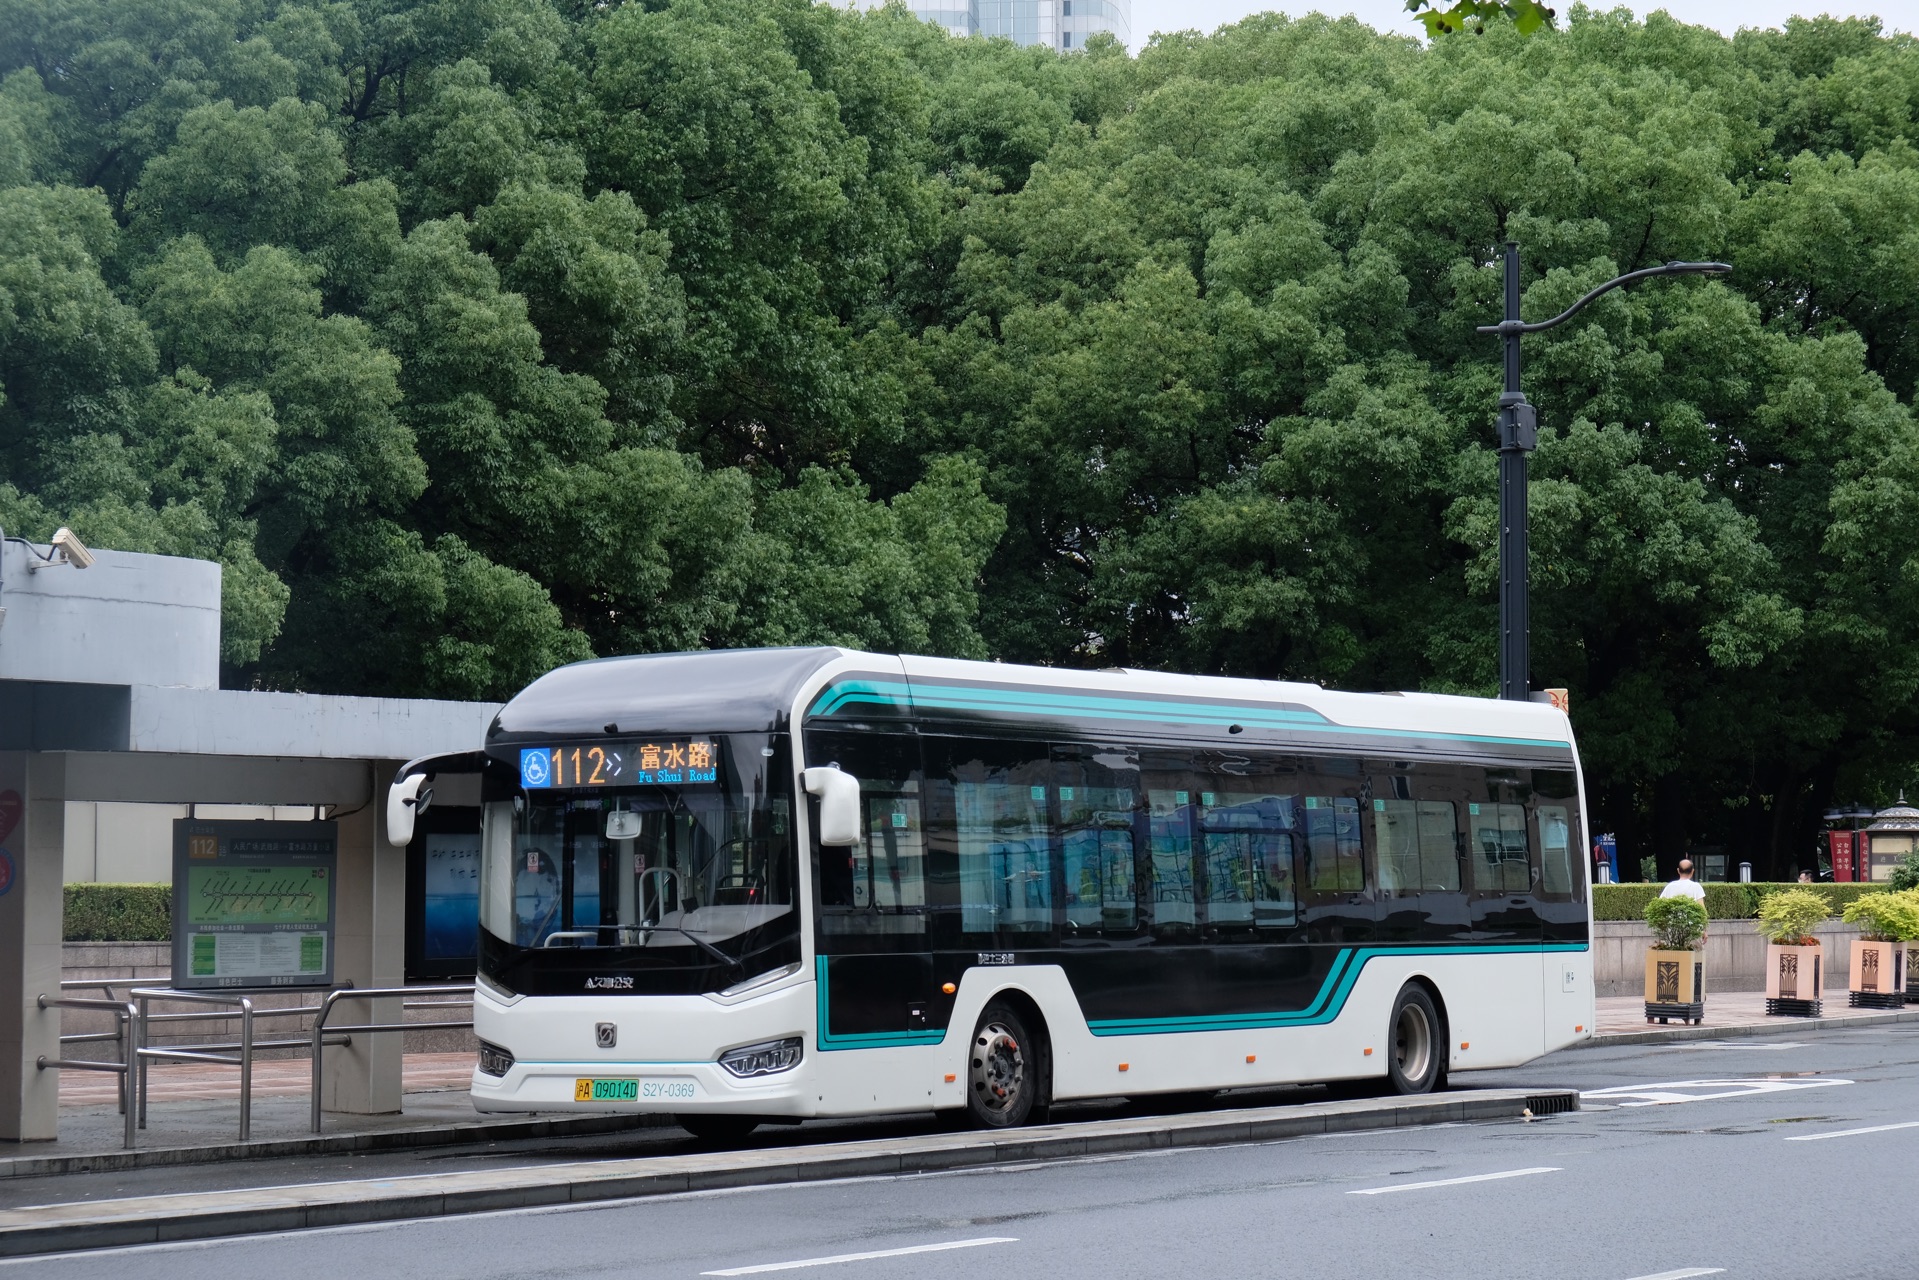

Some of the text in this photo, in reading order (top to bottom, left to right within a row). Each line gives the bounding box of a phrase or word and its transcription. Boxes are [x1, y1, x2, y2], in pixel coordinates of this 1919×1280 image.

[640, 741, 718, 770] 富水路
[552, 747, 605, 785] 112
[638, 767, 716, 784] Fu Shui Road
[191, 839, 215, 855] 112
[642, 1083, 695, 1097] S2Y-0369
